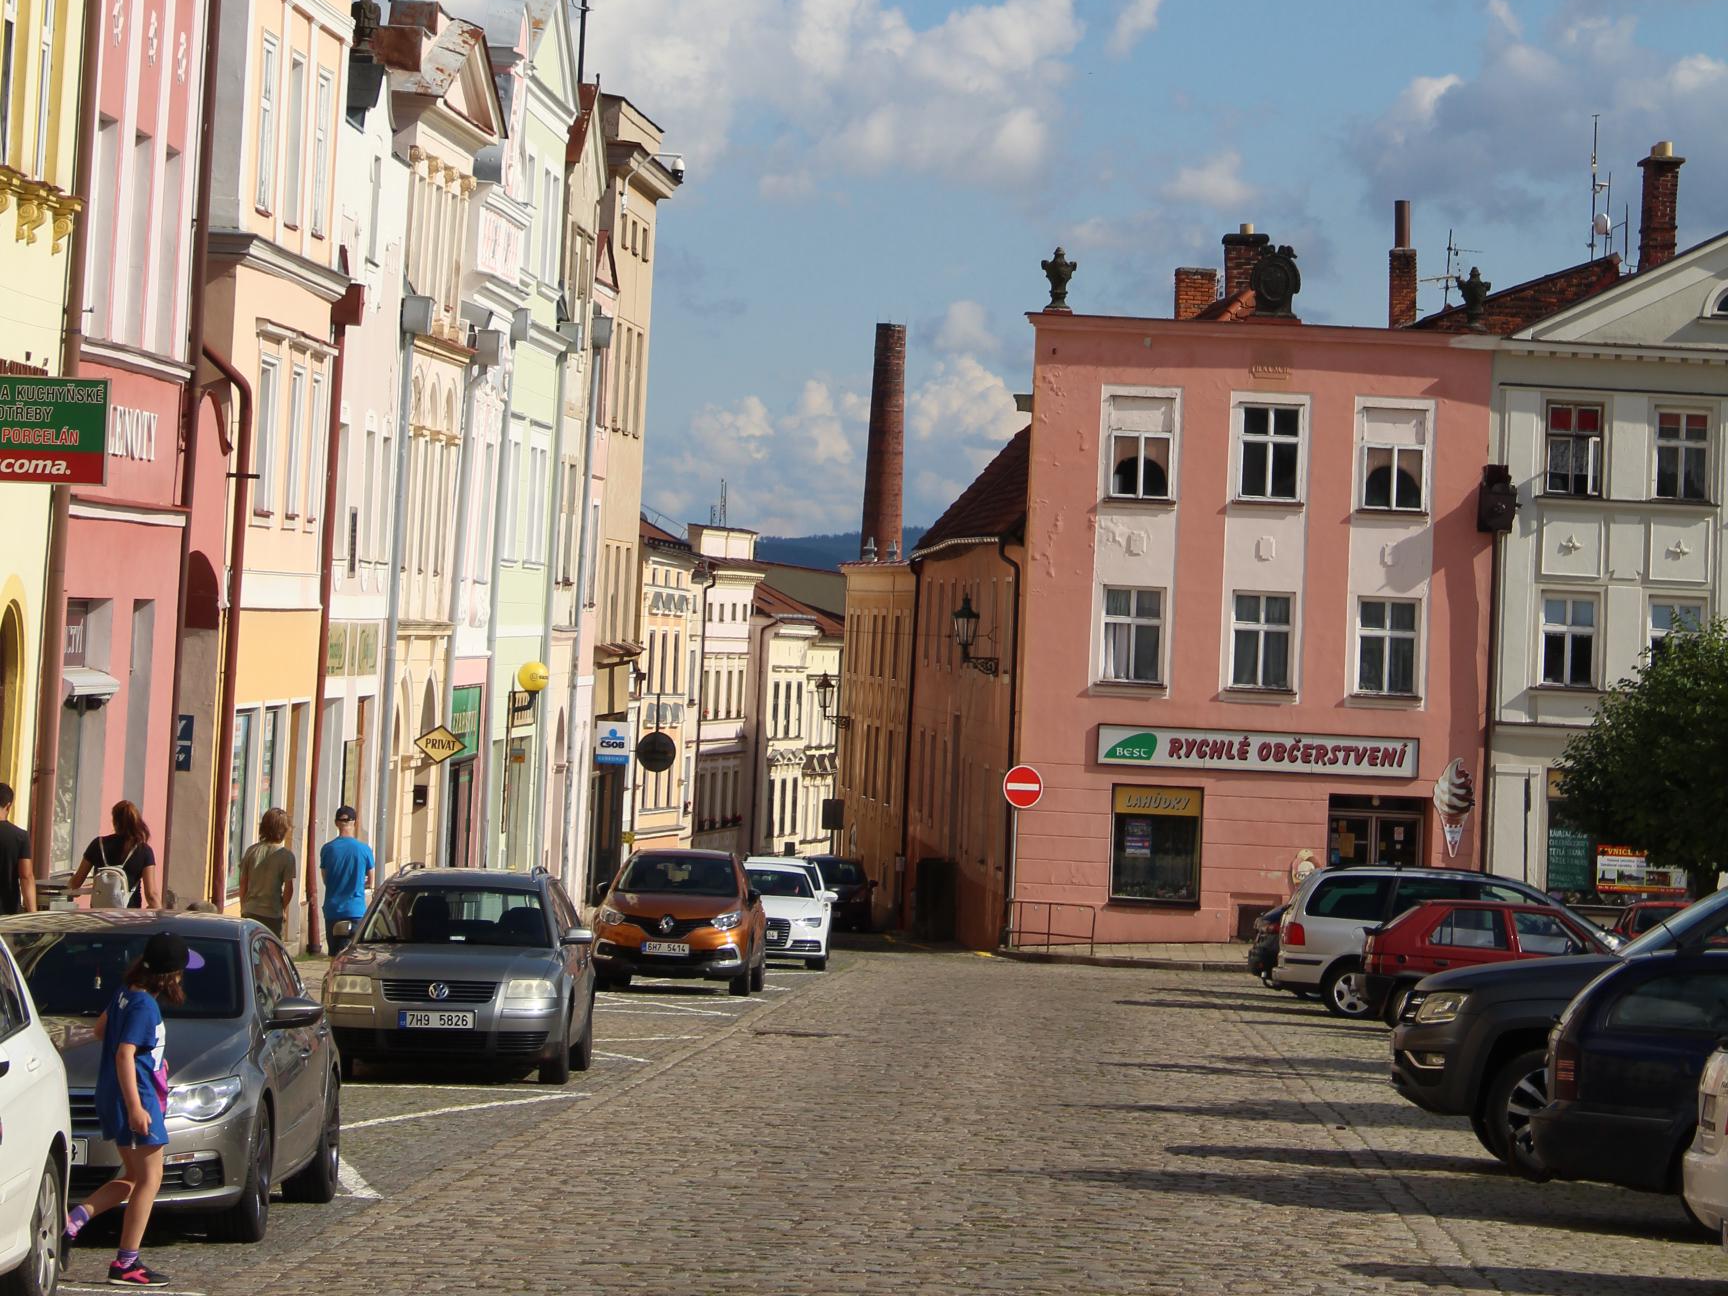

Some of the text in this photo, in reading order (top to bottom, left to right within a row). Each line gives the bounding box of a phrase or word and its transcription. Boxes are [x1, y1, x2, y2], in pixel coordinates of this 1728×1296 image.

[1, 383, 105, 403] A KUCHYŇSKÉ
[2, 426, 80, 445] PORCELÁN
[0, 457, 71, 475] coma.
[425, 737, 457, 752] PRIVAT
[1168, 735, 1251, 761] RYCHLÉ
[1257, 736, 1408, 769] OBČERSTVENÍ
[647, 942, 687, 953] 6H7 5414
[409, 1013, 469, 1027] 7H9 5826
